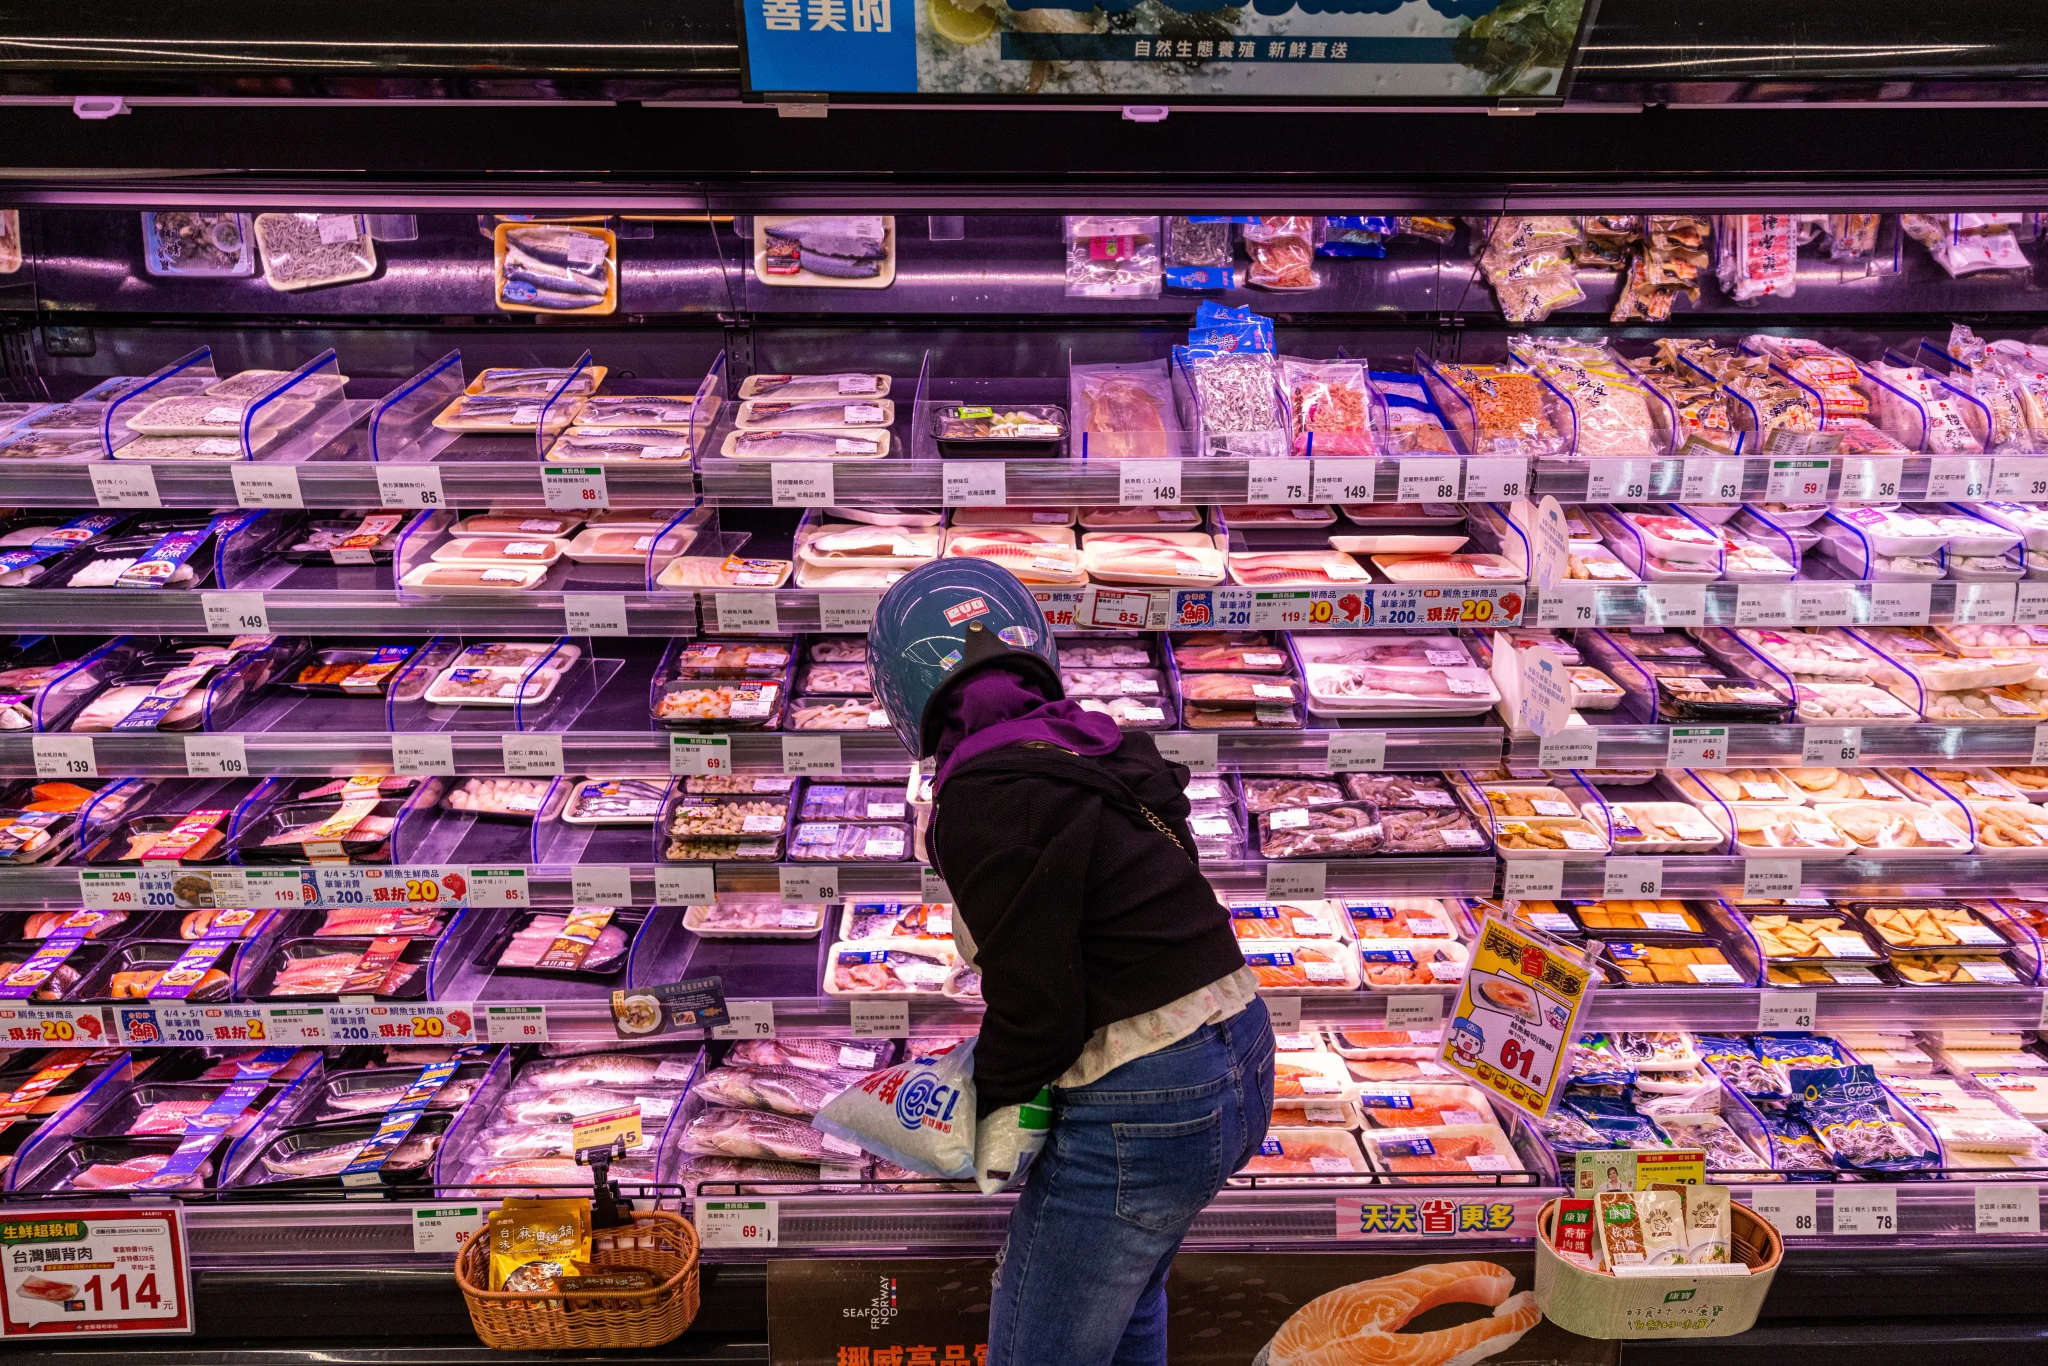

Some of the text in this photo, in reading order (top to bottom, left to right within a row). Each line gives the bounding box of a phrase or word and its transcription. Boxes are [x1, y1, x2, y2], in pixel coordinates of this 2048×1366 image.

[1134, 40, 1349, 59] 自然生態養殖 新鮮直送
[967, 488, 997, 497] 依商品標價
[1153, 486, 1176, 501] 149
[1287, 485, 1303, 499] 75
[1344, 485, 1366, 499] 149
[1437, 484, 1453, 498] 88
[1503, 483, 1519, 496] 98
[1627, 484, 1643, 498] 59
[1721, 484, 1736, 498] 63
[1803, 483, 1818, 495] 59
[1879, 483, 1895, 497] 36
[1967, 483, 1982, 498] 68
[2031, 481, 2048, 495] 39
[420, 490, 438, 504] 85
[581, 489, 596, 501] 88
[1220, 590, 1237, 600] 4/4
[1381, 590, 1399, 599] 4/4
[1408, 589, 1424, 599] 5/1
[1442, 589, 1499, 599] 鯛魚生鮮商品
[1380, 599, 1417, 609] 單筆消費
[1118, 612, 1140, 624] 85
[1281, 610, 1300, 623] 119
[1577, 606, 1592, 619] 78
[239, 615, 263, 629] 149
[1702, 748, 1716, 761] 49
[1840, 747, 1855, 760] 65
[66, 760, 89, 774] 139
[219, 759, 242, 773] 109
[707, 757, 720, 769] 69
[324, 869, 341, 879] 4/4
[349, 868, 364, 879] 5/1
[384, 868, 440, 879] 鯛魚生鮮商品
[324, 879, 361, 889] 單筆消費
[1640, 881, 1655, 894] 68
[112, 891, 132, 904] 249
[274, 890, 295, 902] 119
[505, 889, 519, 901] 85
[819, 885, 834, 899] 89
[17, 1010, 74, 1020] 鯛魚生鮮商品
[163, 1009, 181, 1018] 4/4
[190, 1009, 205, 1018] 5/1
[329, 1007, 346, 1017] 4/4
[355, 1007, 370, 1017] 5/1
[389, 1006, 445, 1017] 鯛魚生鮮商品
[165, 1019, 201, 1029] 單筆消費
[330, 1016, 366, 1027] 單筆消費
[1795, 1014, 1811, 1028] 43
[300, 1026, 320, 1039] 125
[523, 1024, 537, 1036] 89
[754, 1022, 770, 1035] 79
[1500, 1037, 1536, 1080] 61
[1847, 1085, 1873, 1098] eco
[1360, 1199, 1515, 1238] 天天省更多
[1565, 1211, 1589, 1223] 康寶
[1795, 1214, 1812, 1230] 88
[1876, 1214, 1893, 1230] 78
[3, 1222, 80, 1240] 生鮮超殺價
[455, 1231, 470, 1244] 95
[742, 1225, 758, 1239] 69
[1563, 1227, 1587, 1240] 番茄
[1562, 1239, 1587, 1252] 肉醬
[12, 1246, 93, 1266] 台灣鯛背肉
[83, 1272, 175, 1314] 114 元
[842, 1308, 899, 1317] SEAFOOD
[837, 1343, 989, 1366] 挪威高品
